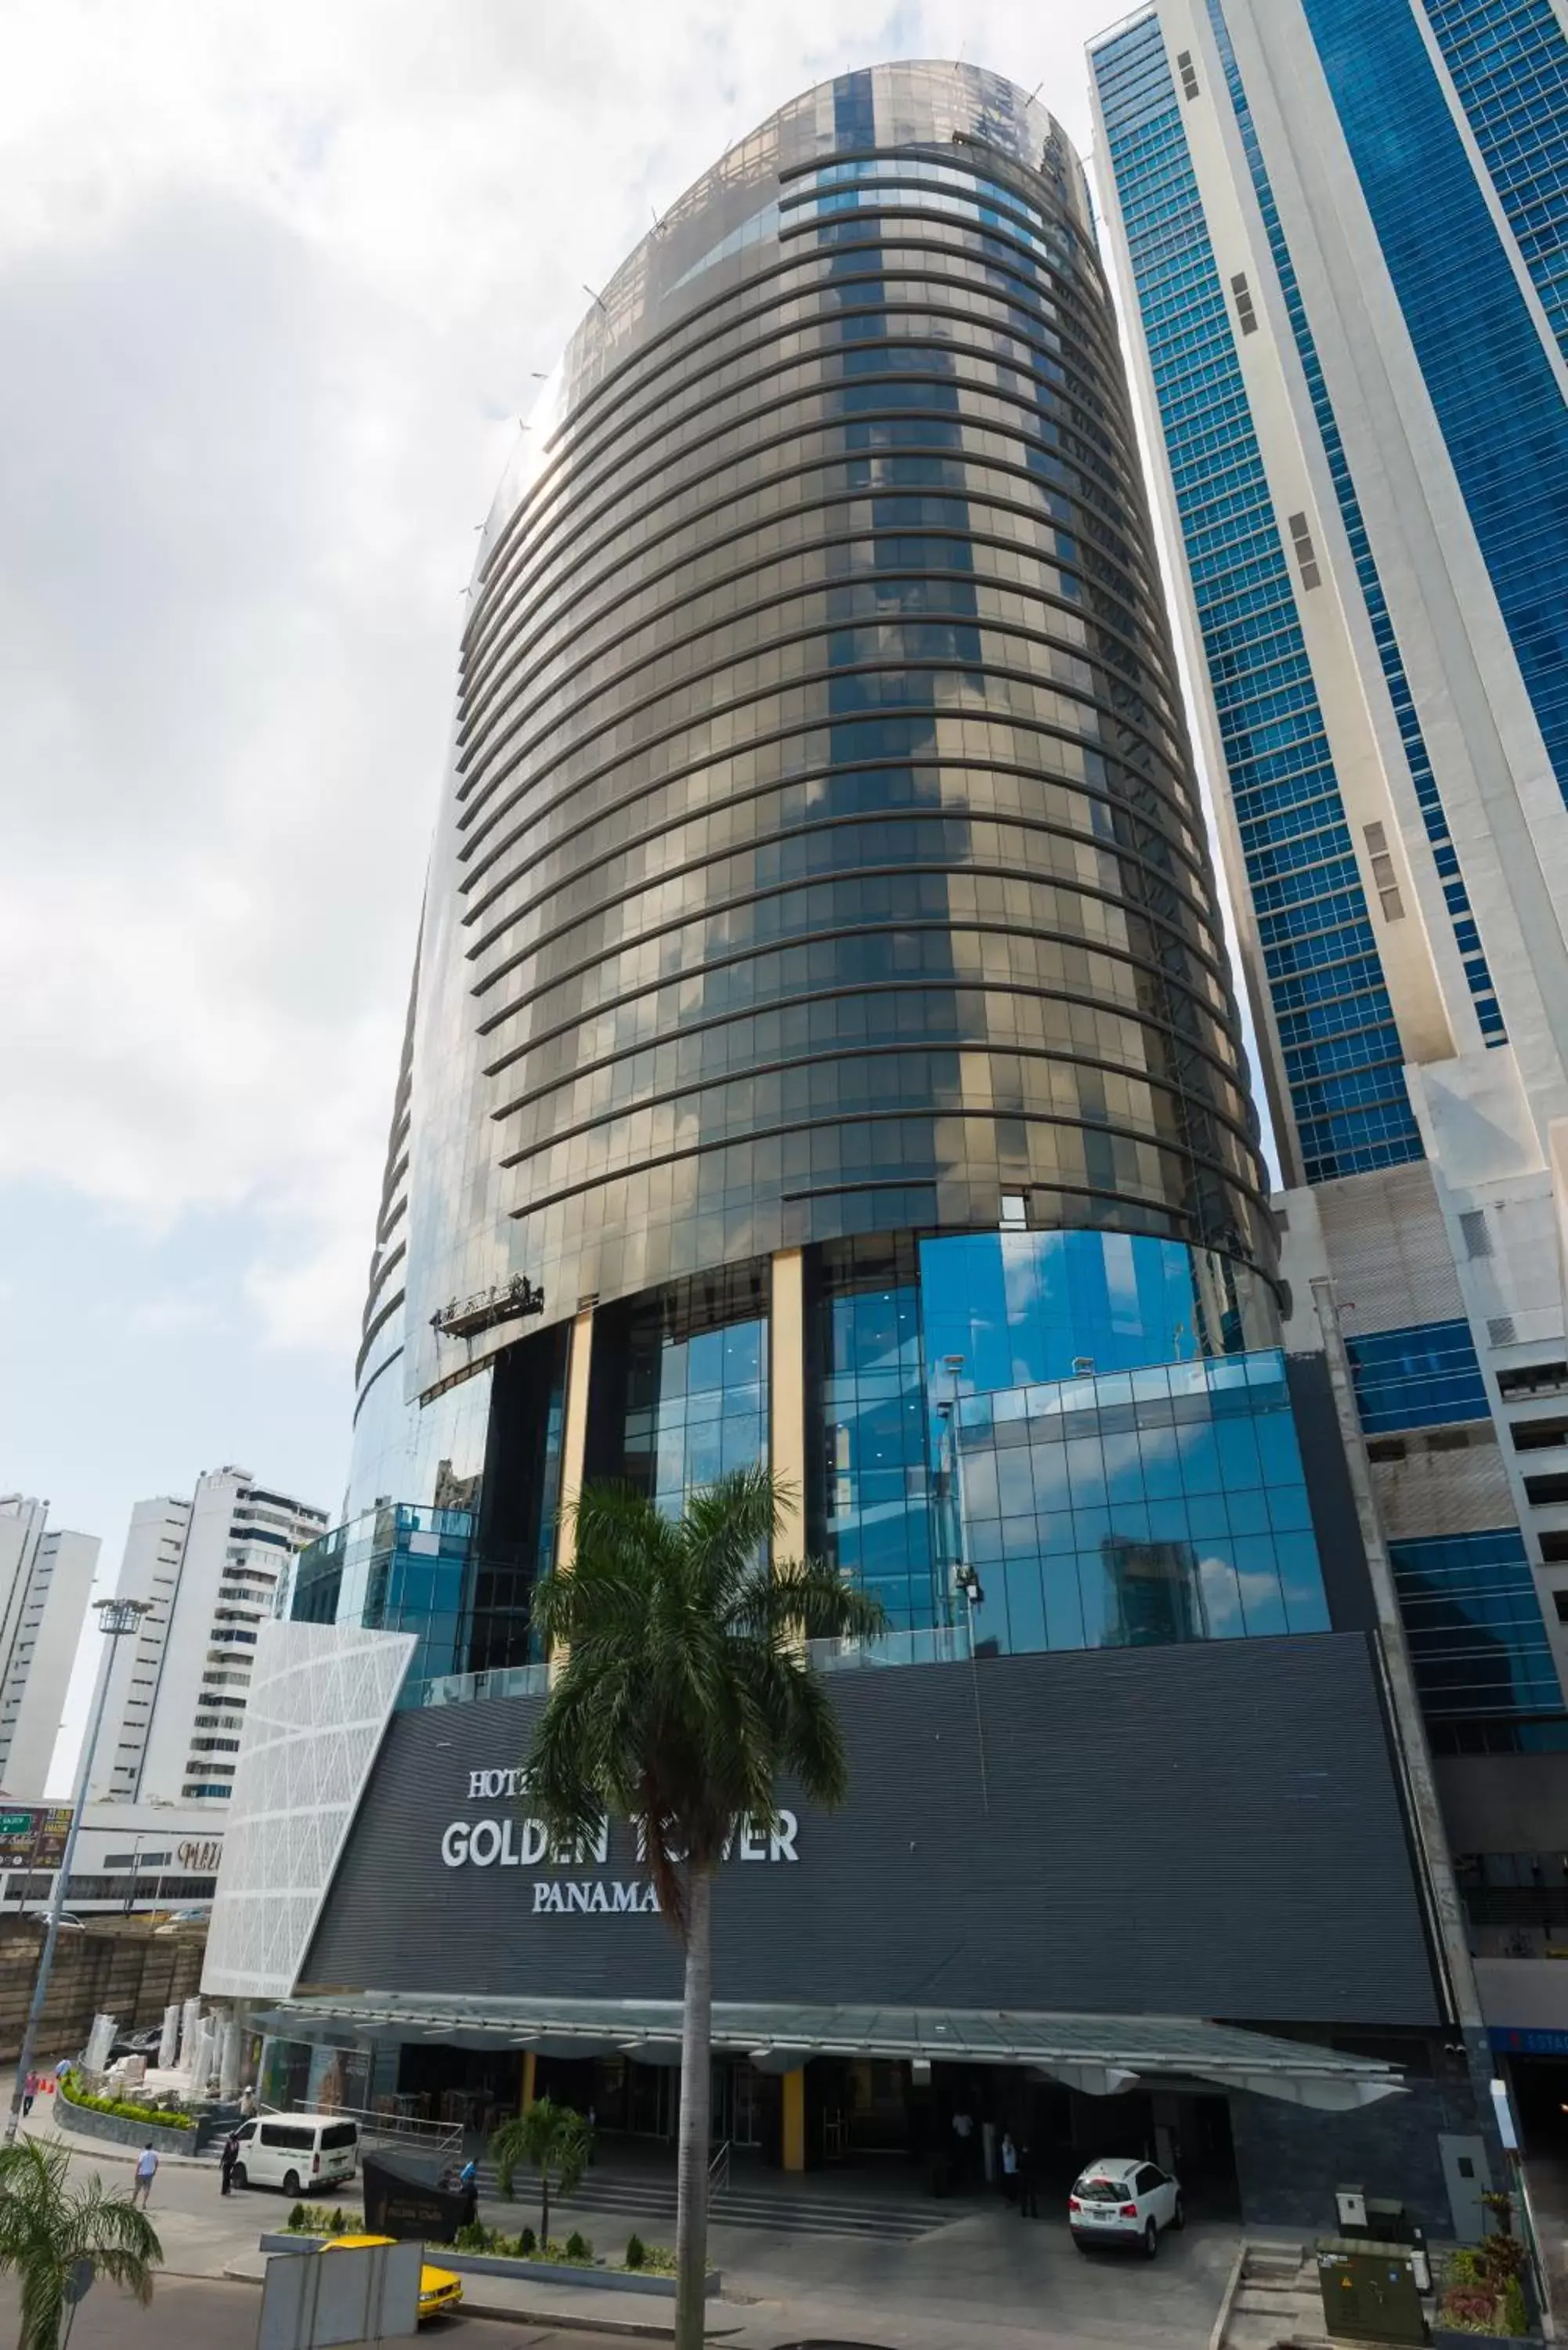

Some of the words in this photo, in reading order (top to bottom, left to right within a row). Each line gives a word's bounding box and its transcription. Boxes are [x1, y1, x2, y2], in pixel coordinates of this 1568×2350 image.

[468, 1769, 542, 1798] HOTE
[629, 1809, 800, 1863] TER
[532, 1880, 662, 1914] PANAMA
